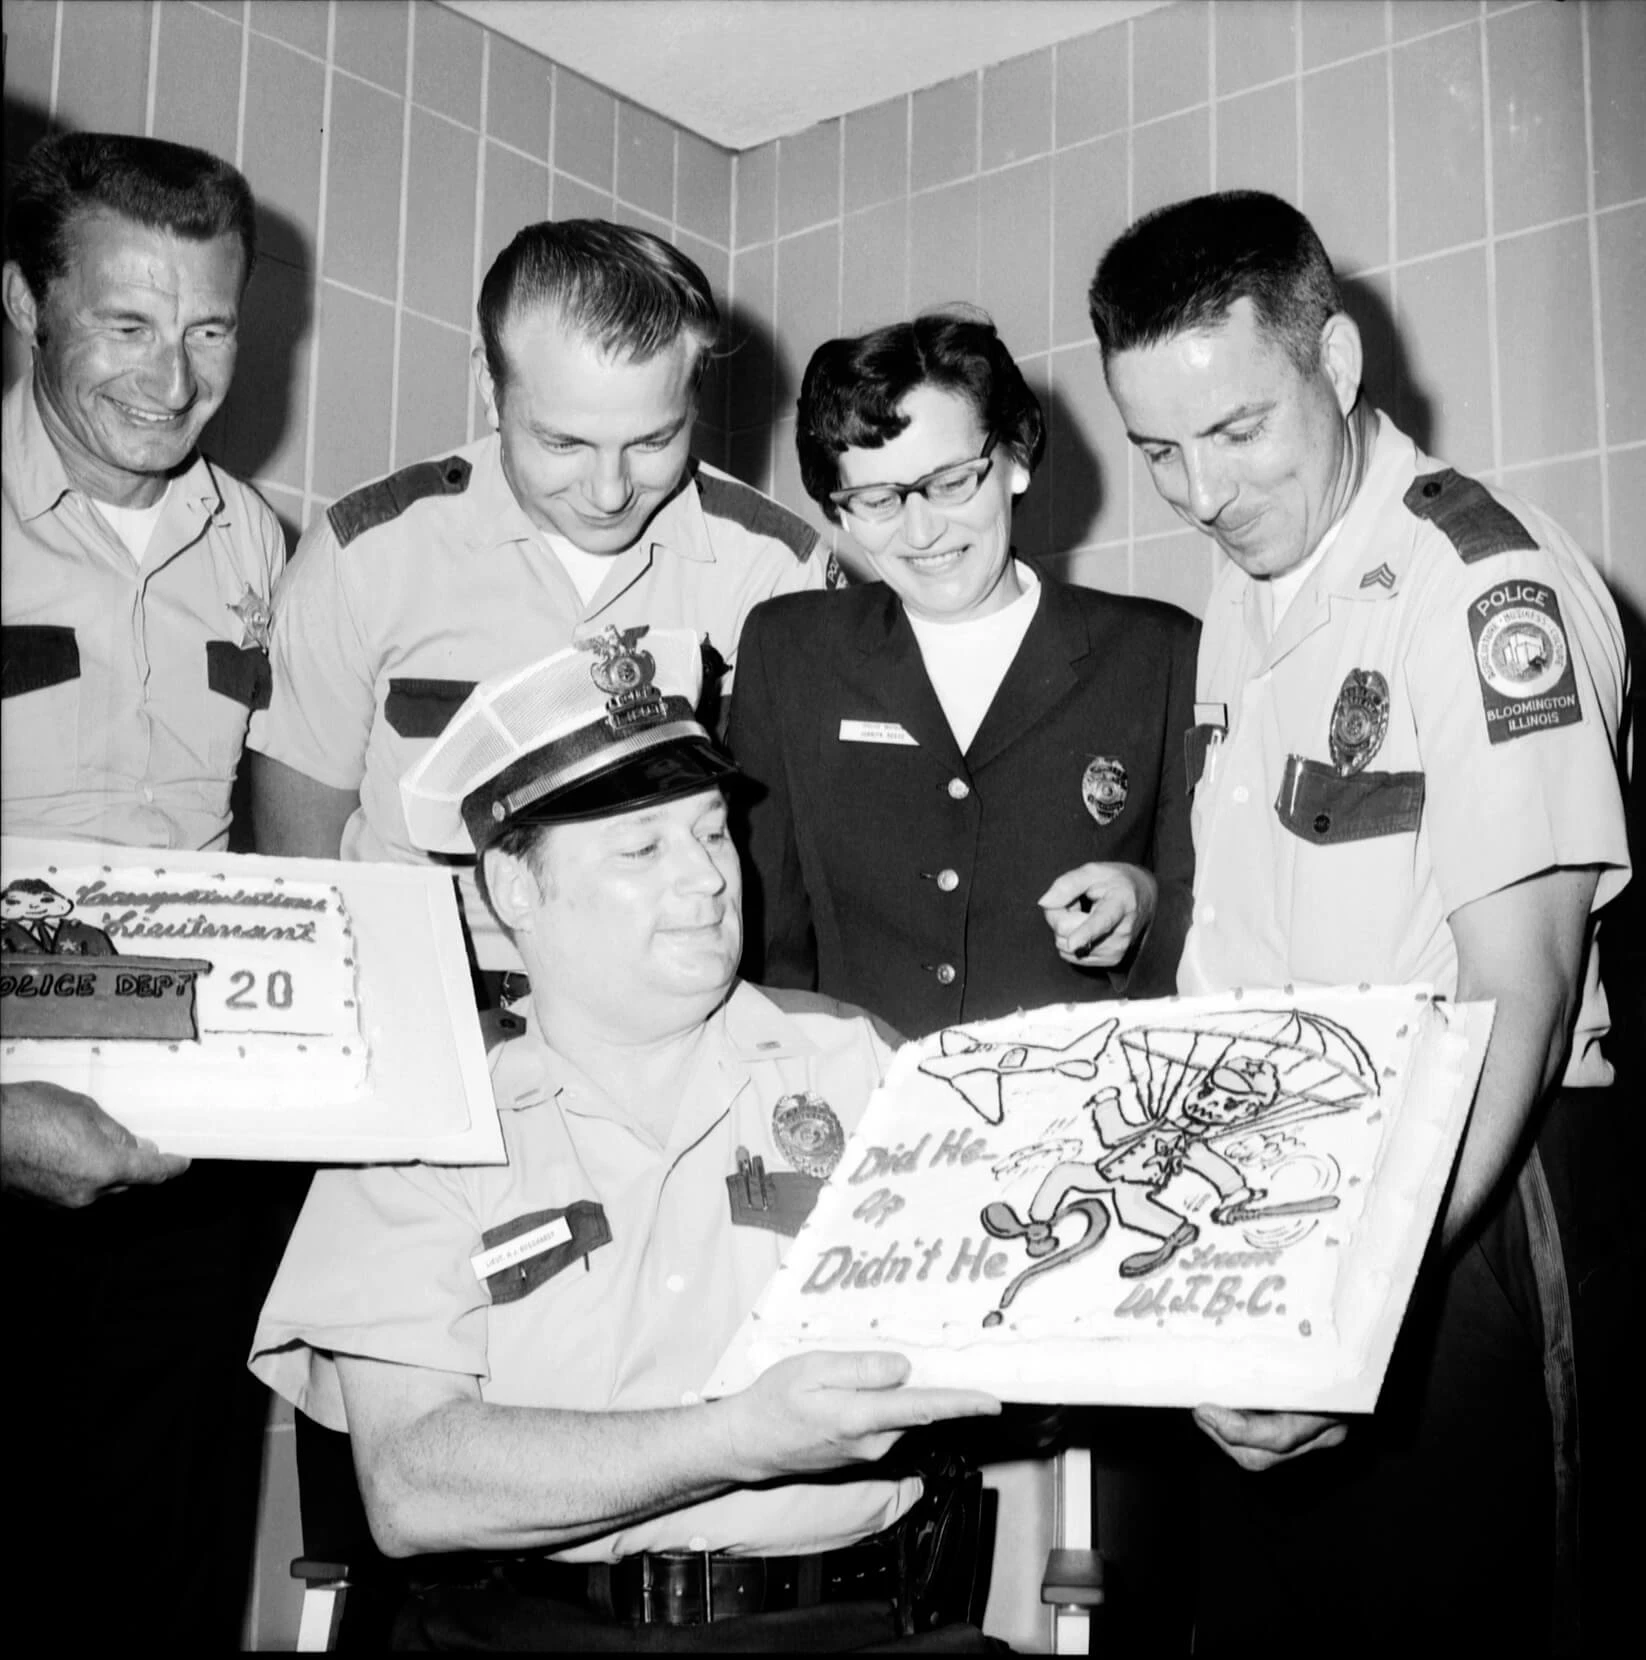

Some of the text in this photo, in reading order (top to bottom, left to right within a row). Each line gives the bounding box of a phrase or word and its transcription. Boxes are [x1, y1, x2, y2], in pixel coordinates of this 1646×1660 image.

[1476, 585, 1549, 617] POLICE
[1486, 694, 1576, 722] BLOOMINGTON
[1508, 711, 1560, 732] ILLINOIS
[103, 910, 317, 943] Lieutenant
[115, 972, 193, 998] DEPT
[225, 970, 294, 1010] 20
[848, 1132, 933, 1185] Did
[800, 1236, 1009, 1295] Didn't He
